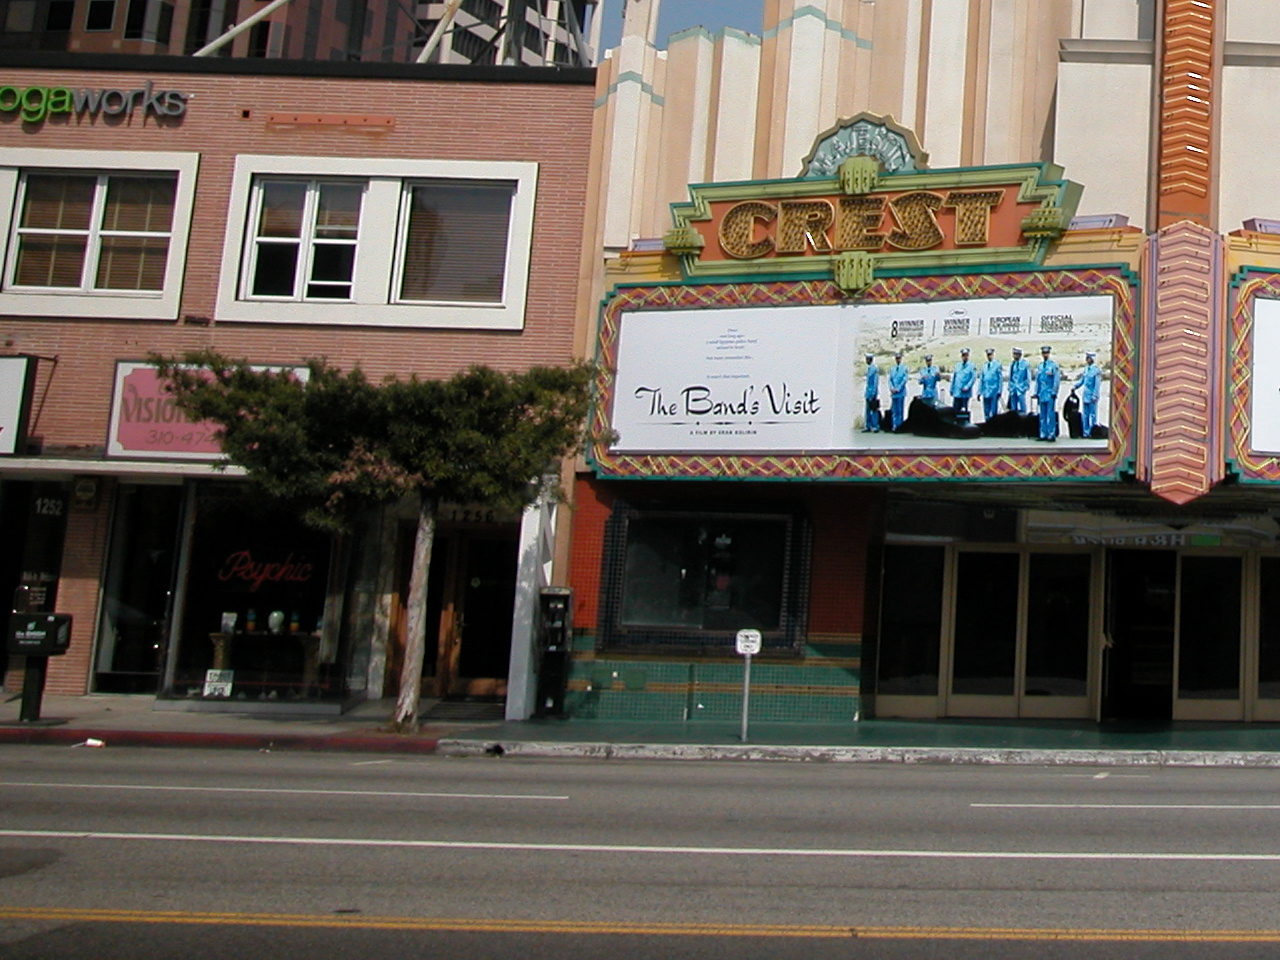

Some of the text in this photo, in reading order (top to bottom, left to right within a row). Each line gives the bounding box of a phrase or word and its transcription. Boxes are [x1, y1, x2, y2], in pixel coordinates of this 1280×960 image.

[718, 189, 1006, 260] CREST
[634, 382, 822, 416] The Band's Visit
[34, 496, 63, 516] 1252
[451, 509, 495, 520] 1256
[218, 551, 312, 592] Psychic
